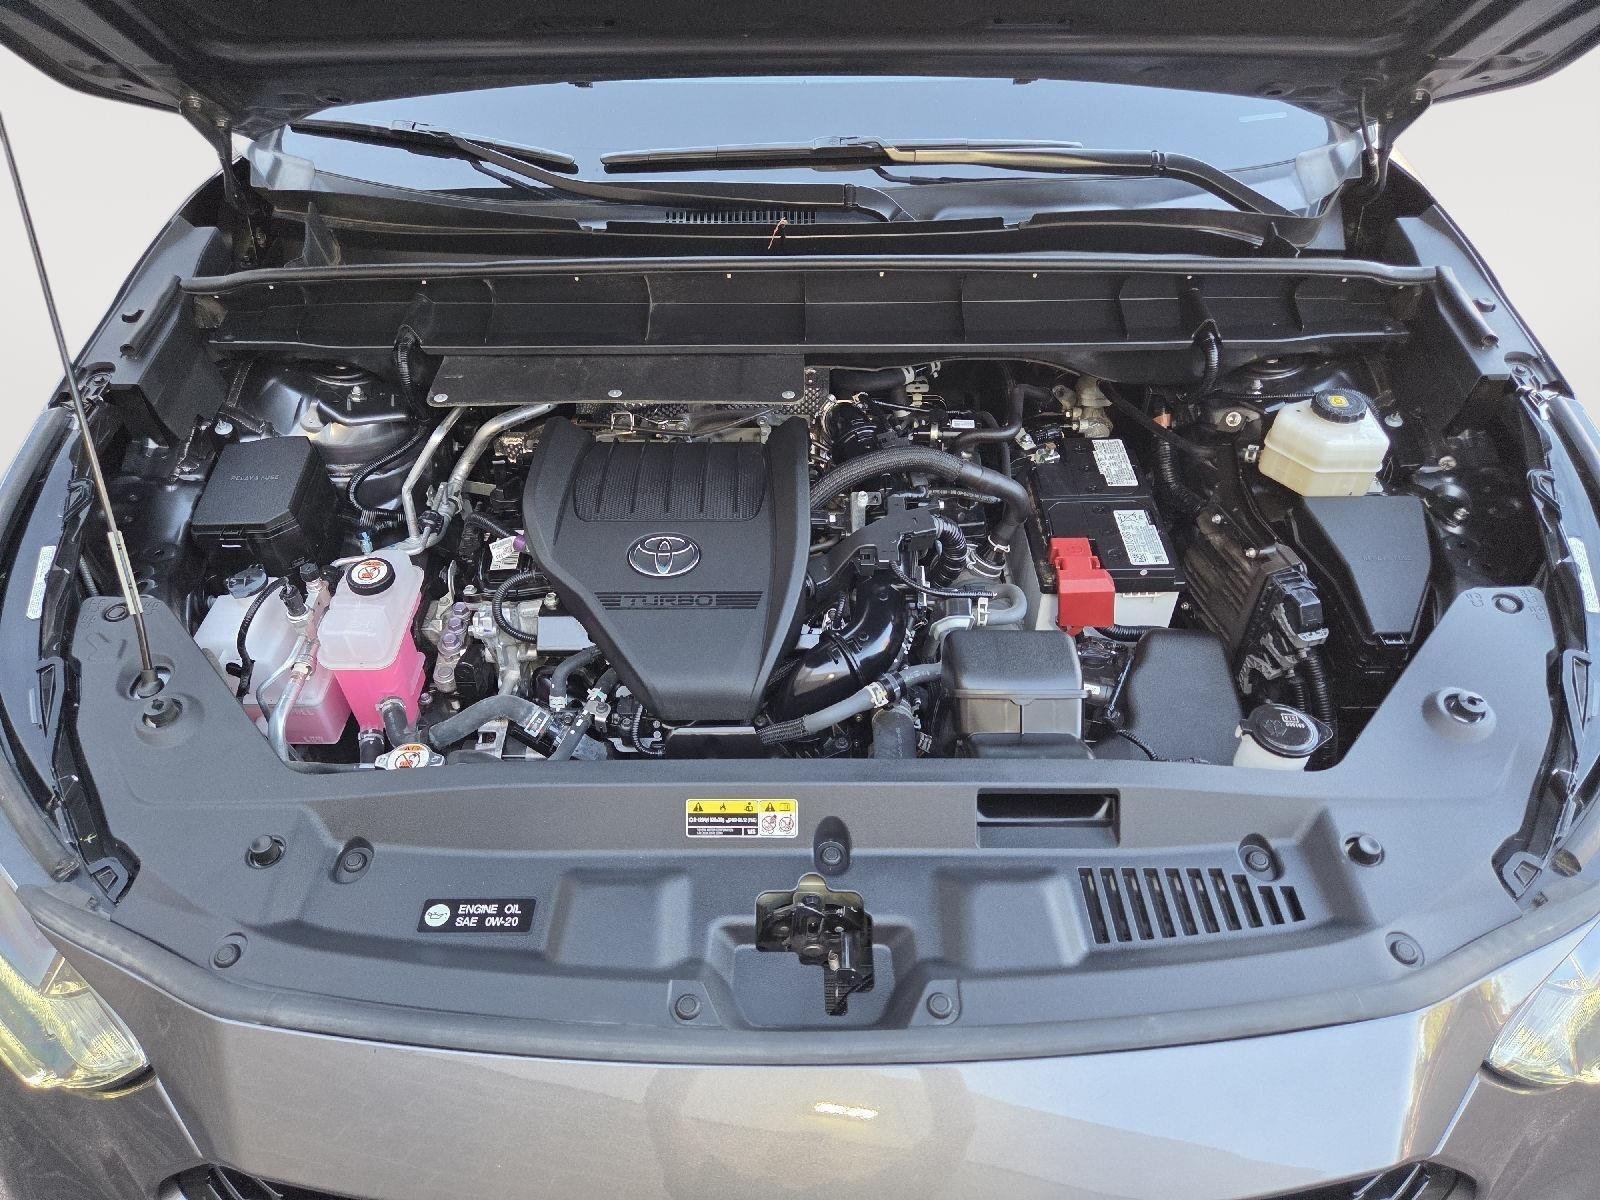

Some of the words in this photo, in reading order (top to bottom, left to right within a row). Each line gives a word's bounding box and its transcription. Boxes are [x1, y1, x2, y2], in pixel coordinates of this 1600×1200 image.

[622, 594, 715, 607] TURBO
[457, 903, 499, 915] ENGINE
[504, 903, 522, 915] OIL
[454, 916, 479, 927] SAE
[484, 916, 519, 927] 0W-20
